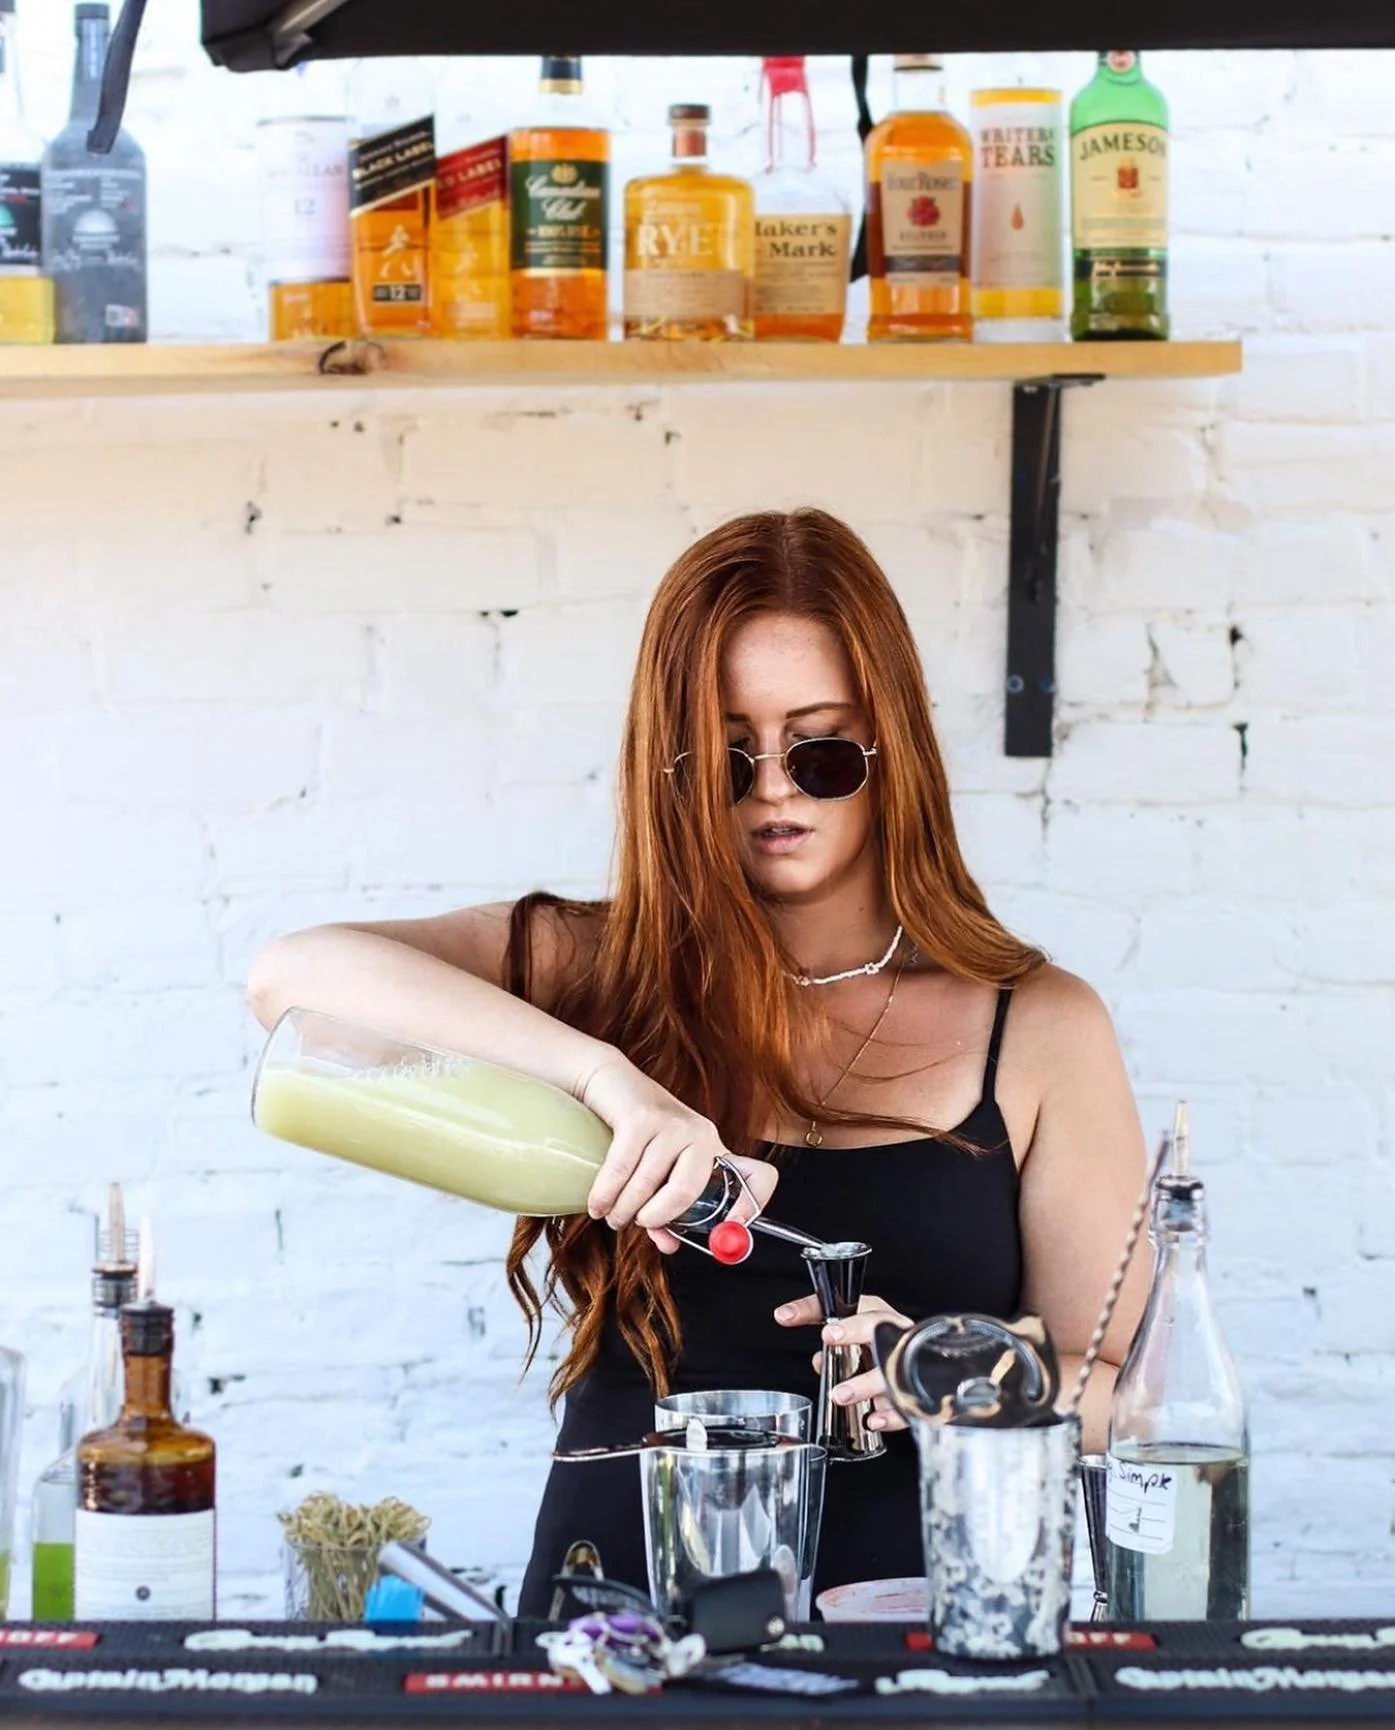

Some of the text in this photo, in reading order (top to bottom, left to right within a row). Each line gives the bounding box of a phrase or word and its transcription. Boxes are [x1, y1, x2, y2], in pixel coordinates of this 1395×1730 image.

[982, 144, 1055, 168] TEARS
[458, 158, 502, 183] LABEL
[637, 223, 713, 256] RYE
[770, 240, 836, 258] Mark
